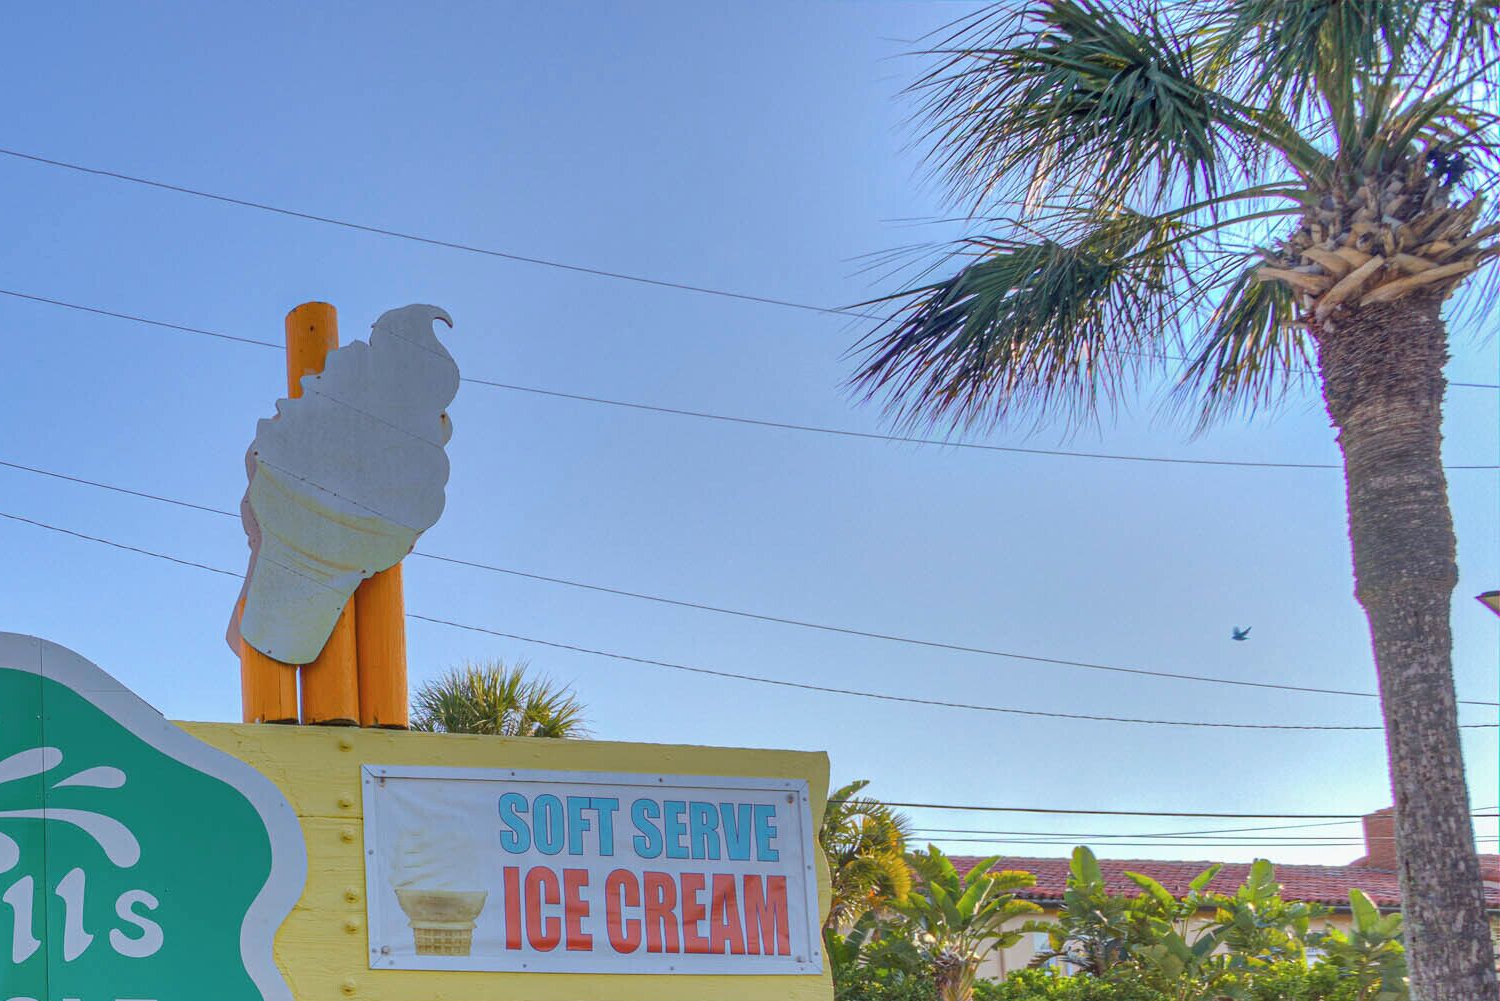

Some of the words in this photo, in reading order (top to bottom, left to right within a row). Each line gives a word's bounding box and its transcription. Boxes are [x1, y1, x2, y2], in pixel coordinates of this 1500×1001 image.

[499, 792, 620, 857] SOFT
[631, 798, 781, 863] SERVE
[503, 866, 594, 953] ICE
[604, 869, 792, 956] CREAM
